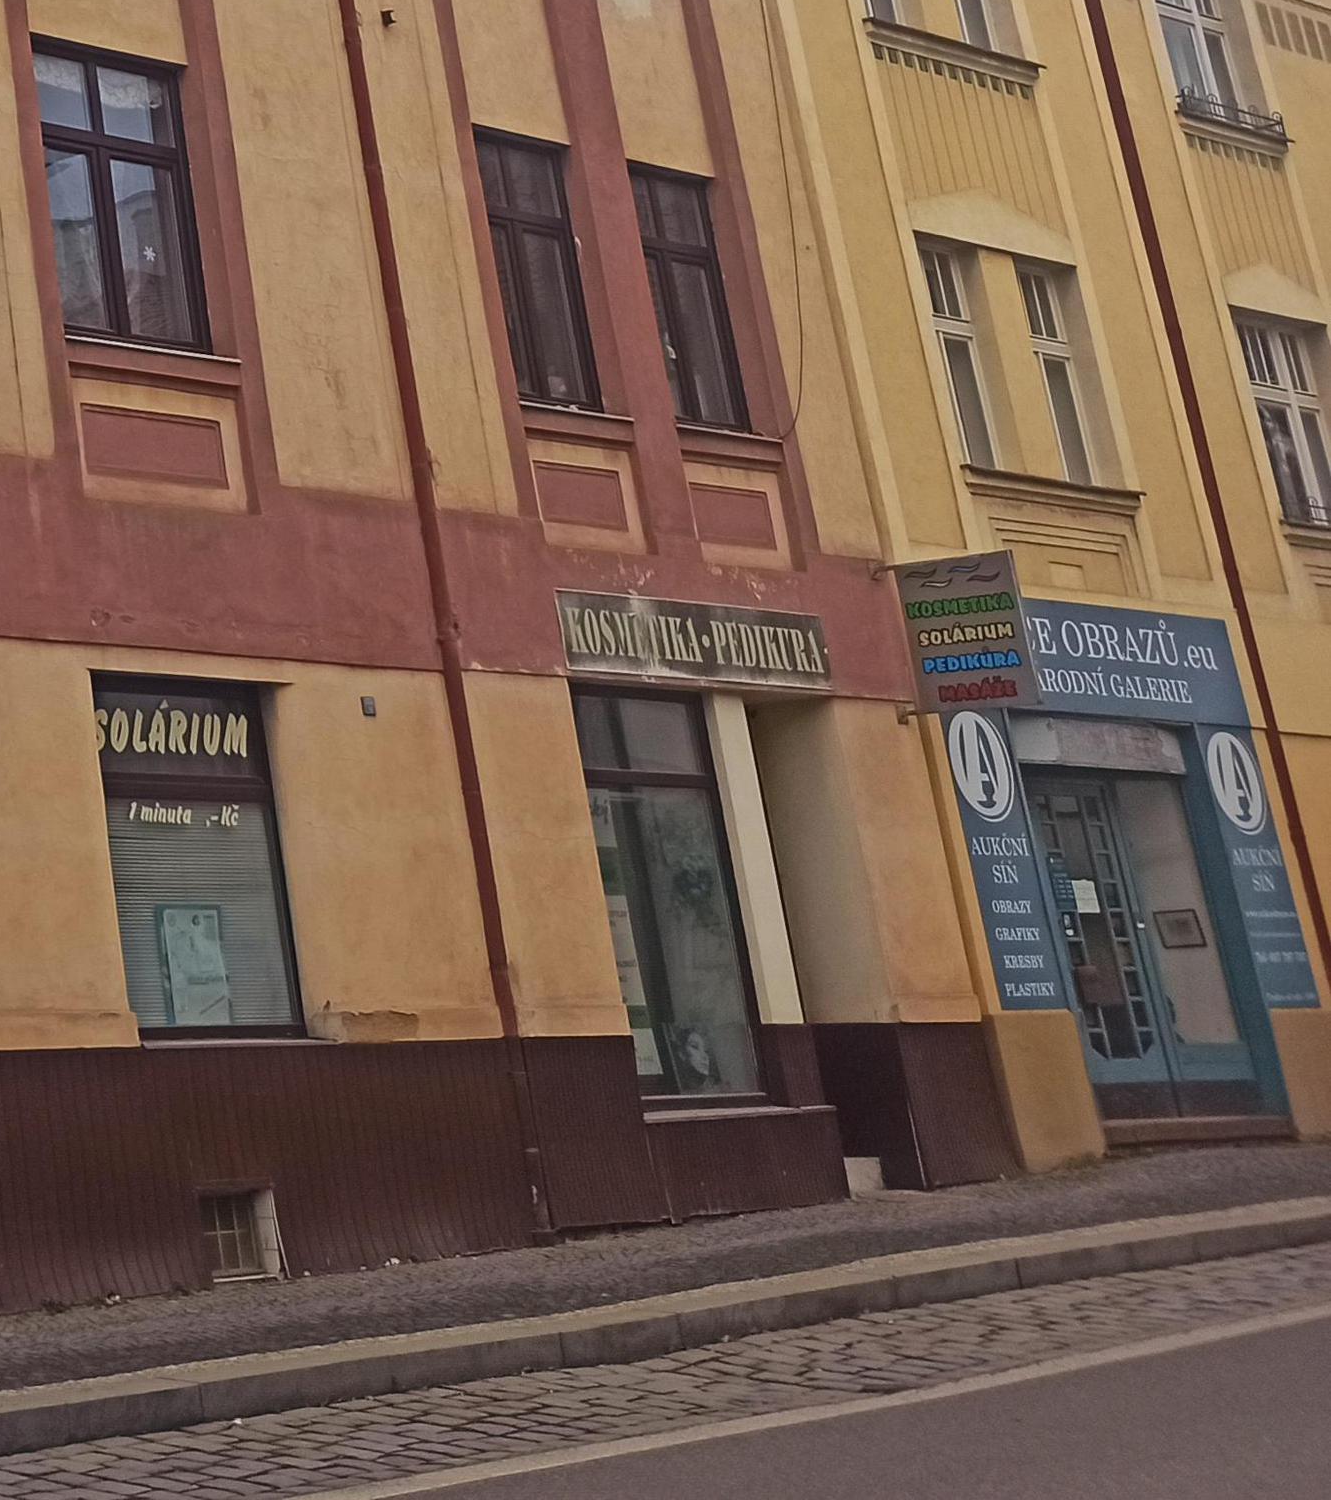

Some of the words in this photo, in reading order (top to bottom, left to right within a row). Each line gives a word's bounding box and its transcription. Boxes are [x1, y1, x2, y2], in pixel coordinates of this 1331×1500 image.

[905, 592, 1014, 619] KOSMETIKA
[565, 607, 703, 663] KOSMETIKA
[709, 619, 825, 673] PEDIKURA
[918, 622, 1015, 647] SOLÁRIUM
[938, 675, 1018, 702] MASÁŽE
[1109, 673, 1193, 704] GALERIE
[95, 699, 248, 758] SOLÁRIUM
[129, 801, 138, 821] 1
[140, 802, 192, 825] minuta
[971, 833, 1030, 857] AUKČNÍ
[992, 861, 1019, 884] SÍŇ
[992, 900, 1032, 914] OBRAZY
[995, 927, 1040, 941] GRAFIKY
[1003, 955, 1044, 969] KRESBY
[1005, 983, 1055, 997] PLASTIKY
